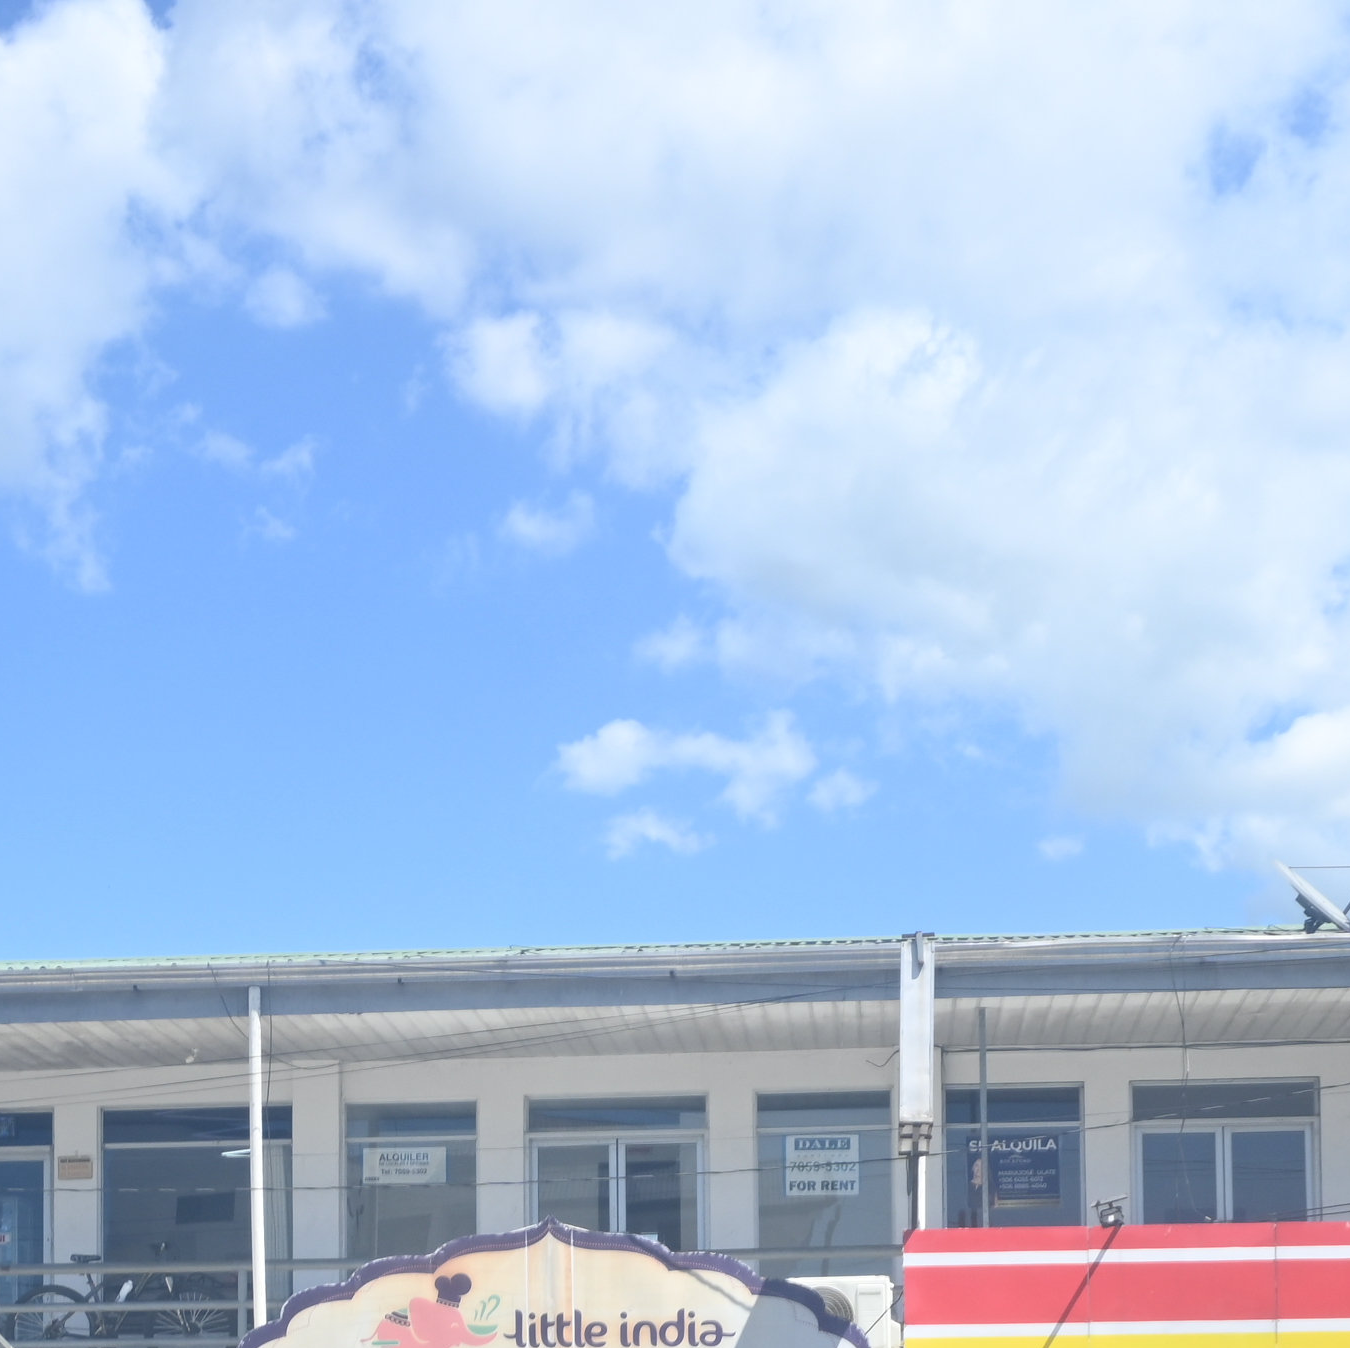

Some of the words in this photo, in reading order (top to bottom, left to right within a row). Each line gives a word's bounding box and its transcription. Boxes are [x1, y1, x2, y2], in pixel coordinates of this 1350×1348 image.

[798, 1139, 848, 1149] DALE
[991, 1139, 1057, 1153] ALQUILA
[379, 1153, 429, 1162] ALQUILER
[789, 1161, 856, 1172] 7059-5302
[789, 1180, 817, 1192] FOR
[821, 1180, 857, 1191] RENT
[503, 1308, 609, 1348] little
[619, 1308, 737, 1348] india
